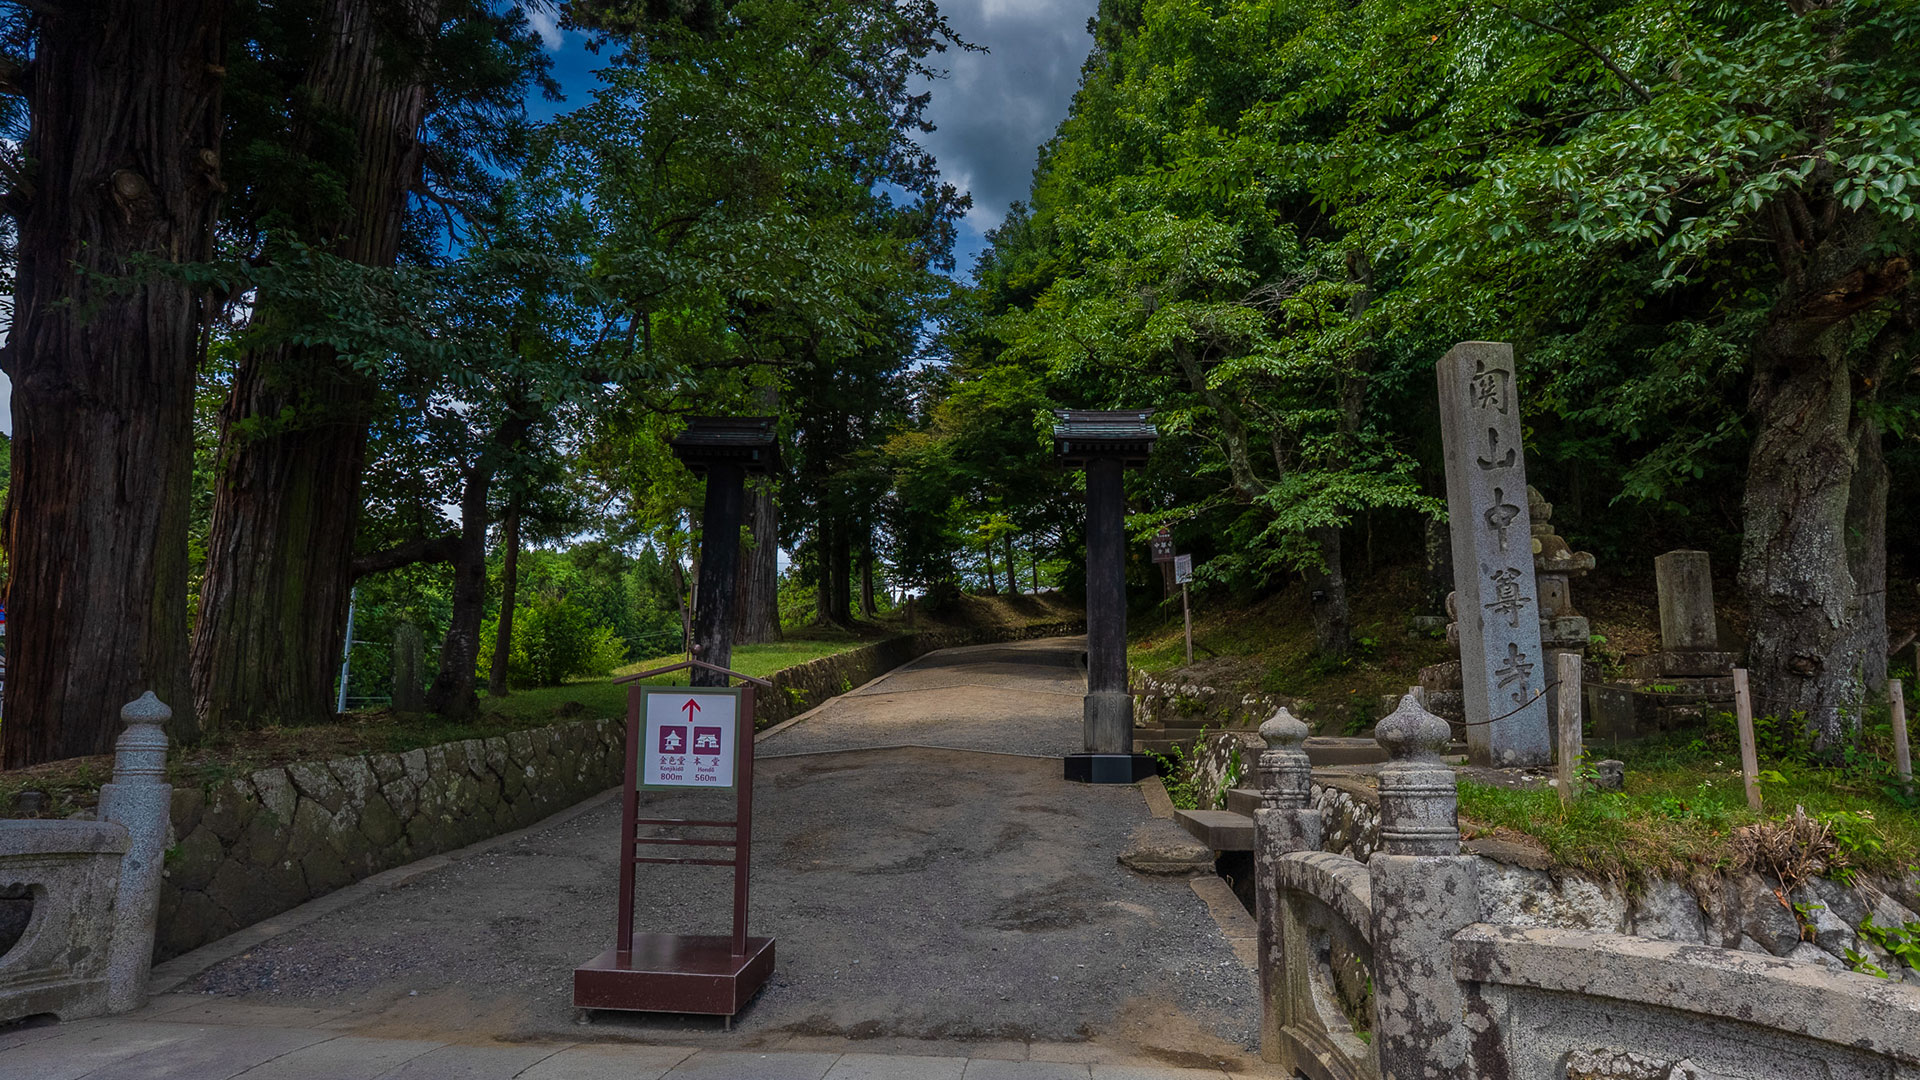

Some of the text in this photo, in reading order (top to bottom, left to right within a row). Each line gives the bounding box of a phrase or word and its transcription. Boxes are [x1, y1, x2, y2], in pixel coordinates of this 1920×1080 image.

[660, 756, 686, 765] 金色堂
[660, 773, 683, 781] 800m
[695, 774, 717, 782] 560m
